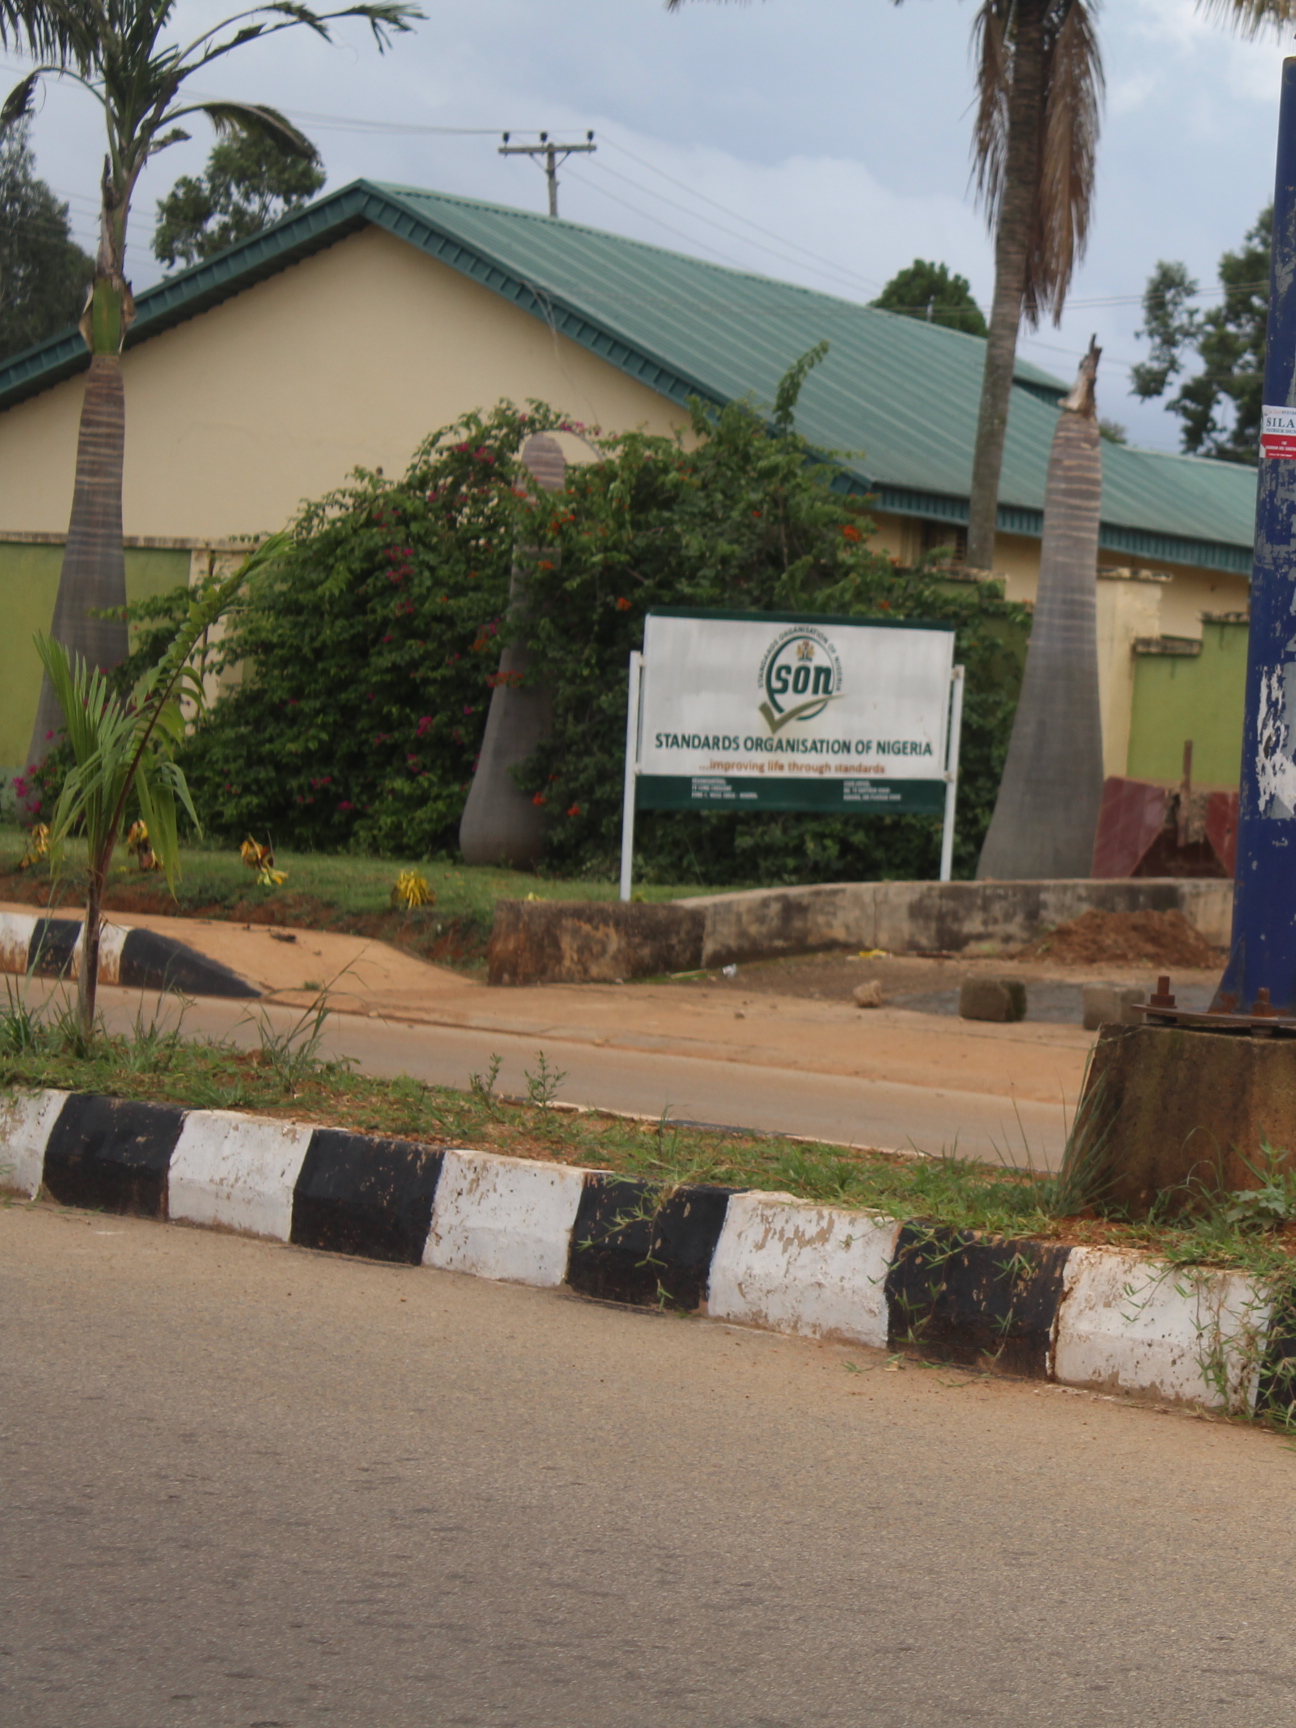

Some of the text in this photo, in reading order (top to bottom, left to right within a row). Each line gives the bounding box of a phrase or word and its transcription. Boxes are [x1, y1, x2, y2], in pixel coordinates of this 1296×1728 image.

[655, 732, 933, 756] STANDARDS ORGANISATION OF NIGERIA
[767, 760, 784, 772] life
[787, 761, 831, 775] through
[834, 762, 885, 774] standards
